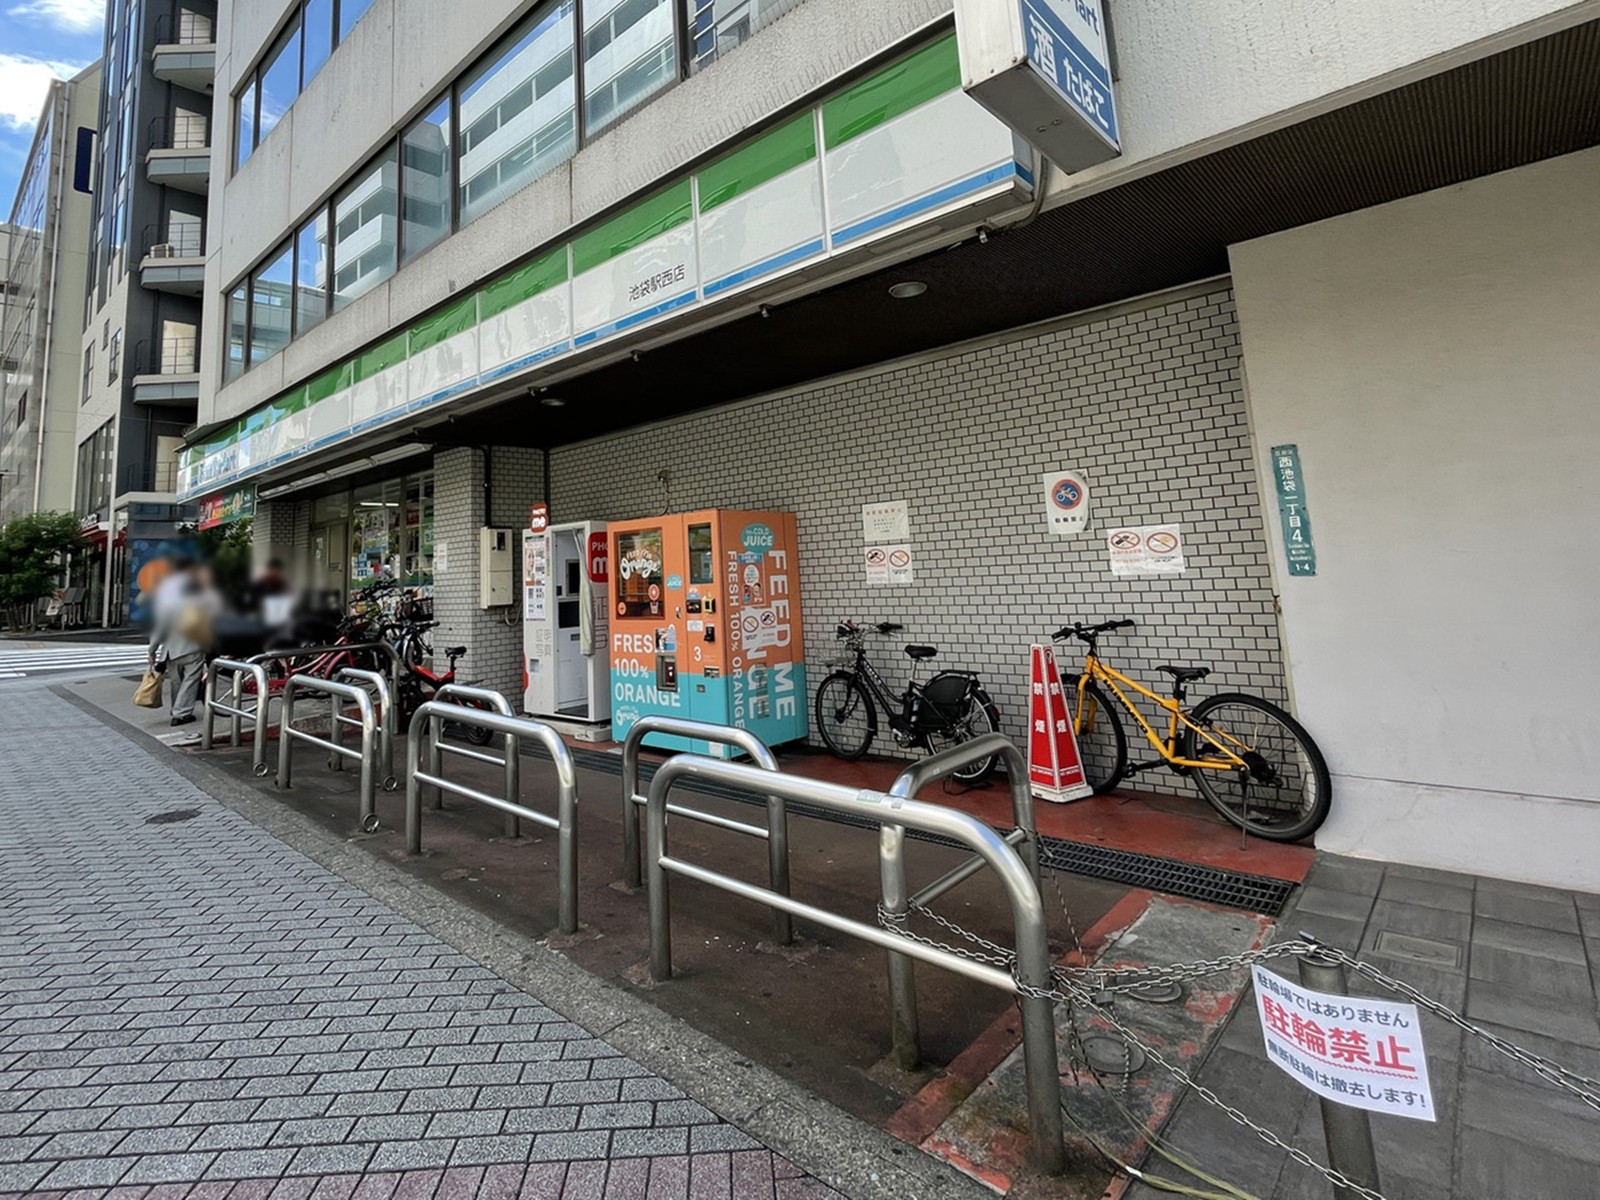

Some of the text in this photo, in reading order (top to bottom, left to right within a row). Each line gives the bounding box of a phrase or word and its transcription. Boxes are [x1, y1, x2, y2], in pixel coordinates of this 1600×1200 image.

[1029, 13, 1109, 129] 酒 たばこ
[629, 264, 685, 302] 池袋駅西店
[743, 535, 773, 547] JUICE
[727, 551, 740, 606] FRESH
[1295, 563, 1310, 571] 1-4
[613, 634, 657, 654] FRES
[730, 612, 741, 651] 100%
[614, 658, 649, 678] 100%
[693, 646, 702, 661] 3
[615, 683, 681, 707] ORANGE
[773, 661, 796, 720] ME
[1257, 972, 1409, 1028] 駐輪場ではありません
[1261, 993, 1416, 1073] 駐輪禁止
[1267, 1038, 1426, 1108] 無断駐輪は撤去します!
